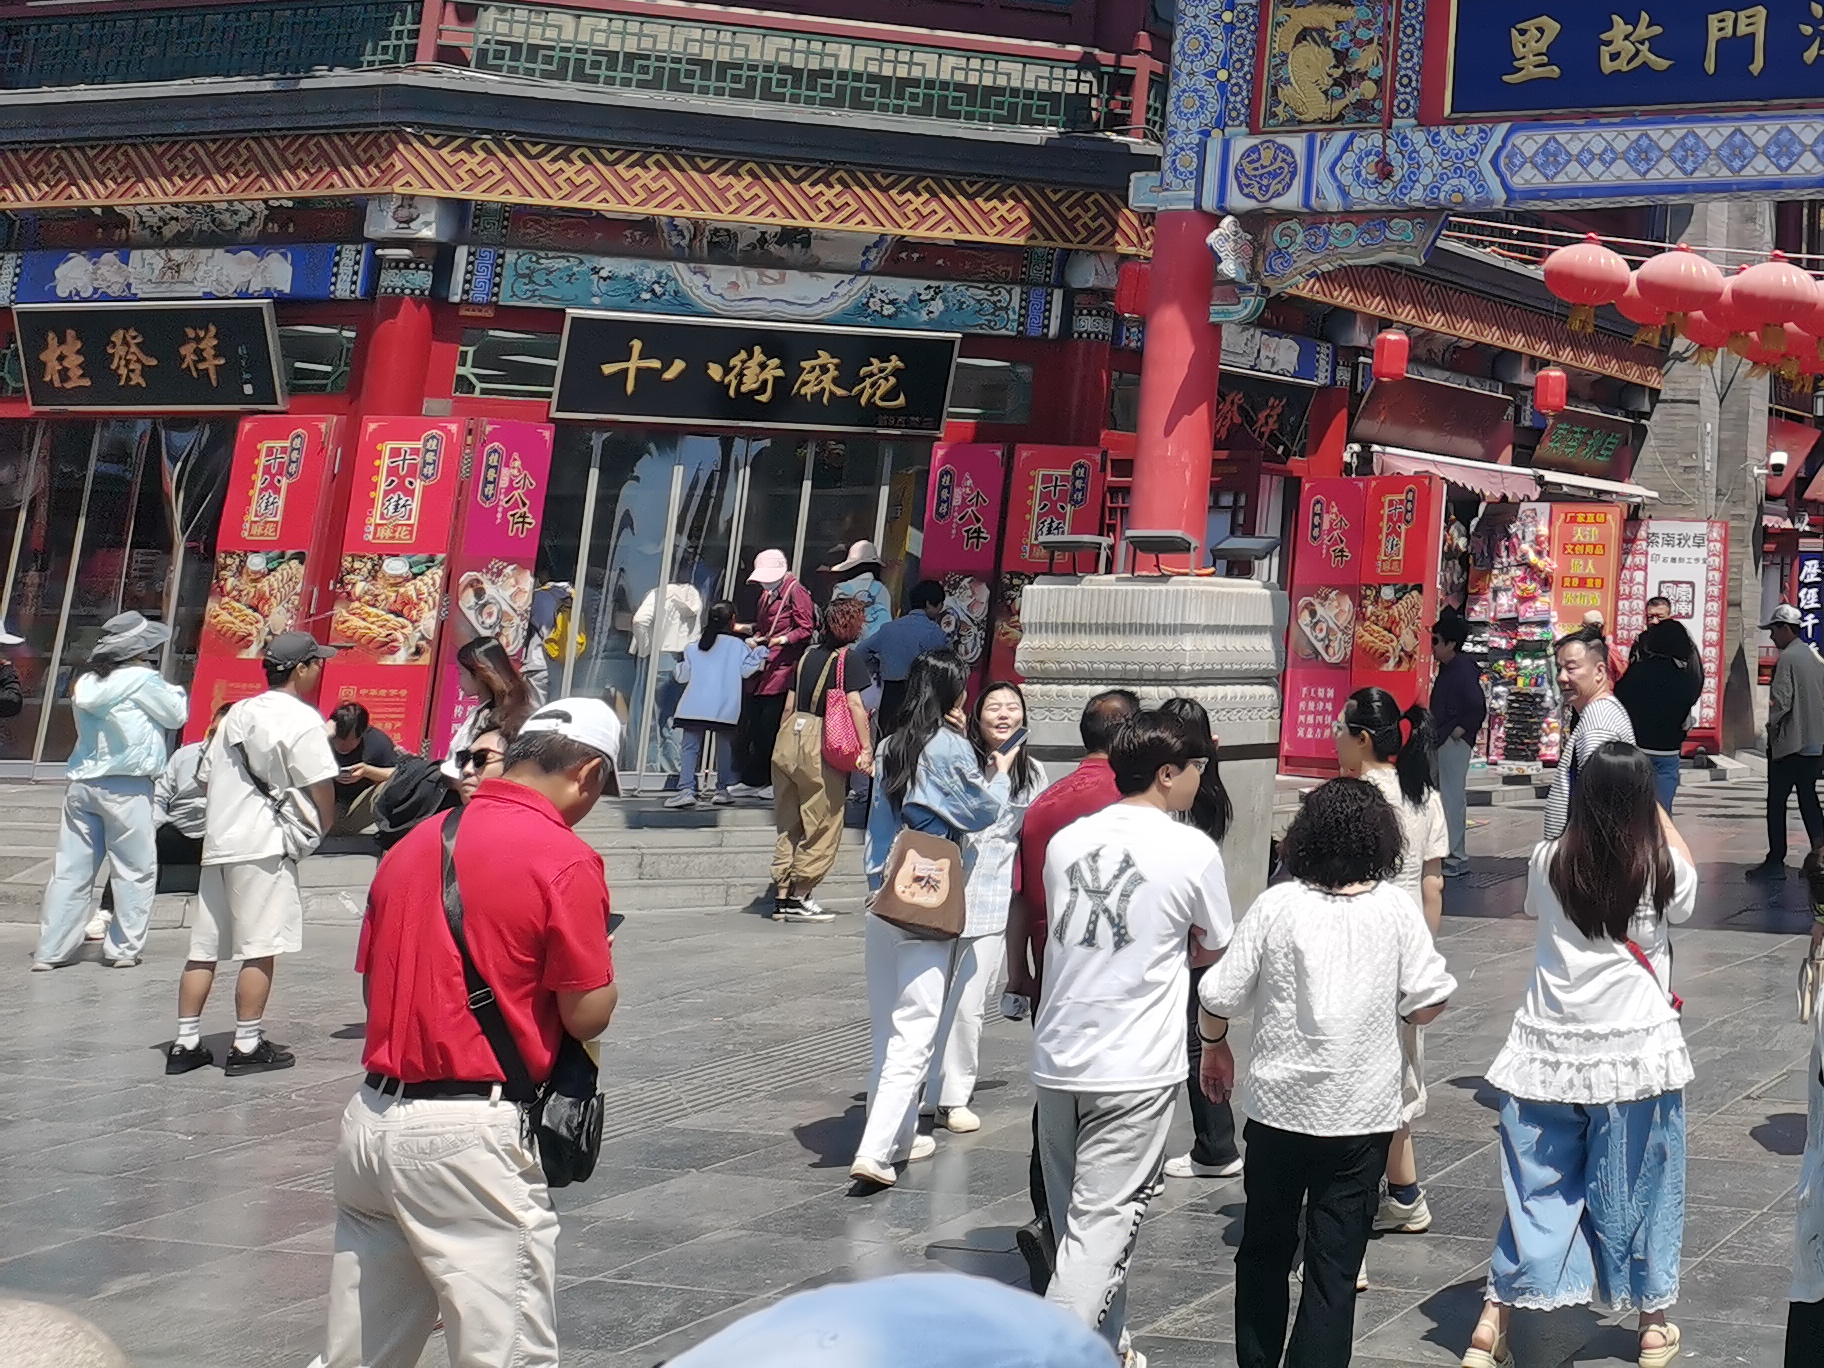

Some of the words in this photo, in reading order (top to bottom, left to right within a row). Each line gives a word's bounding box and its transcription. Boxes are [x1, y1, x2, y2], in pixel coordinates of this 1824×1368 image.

[39, 322, 225, 389] 桂發祥
[600, 338, 907, 409] 十八街麻花
[257, 446, 286, 517] 十八街
[382, 447, 418, 519] 十八街
[502, 470, 536, 538] 小八件
[1038, 475, 1069, 537] 十八街
[250, 523, 275, 536] 麻花
[376, 525, 412, 540] 麻花
[957, 489, 990, 551] 小八件
[1326, 515, 1351, 568] 小八件
[1385, 499, 1404, 556] 十八街
[1565, 512, 1606, 523] 厂家直销
[1572, 527, 1599, 541] 天津
